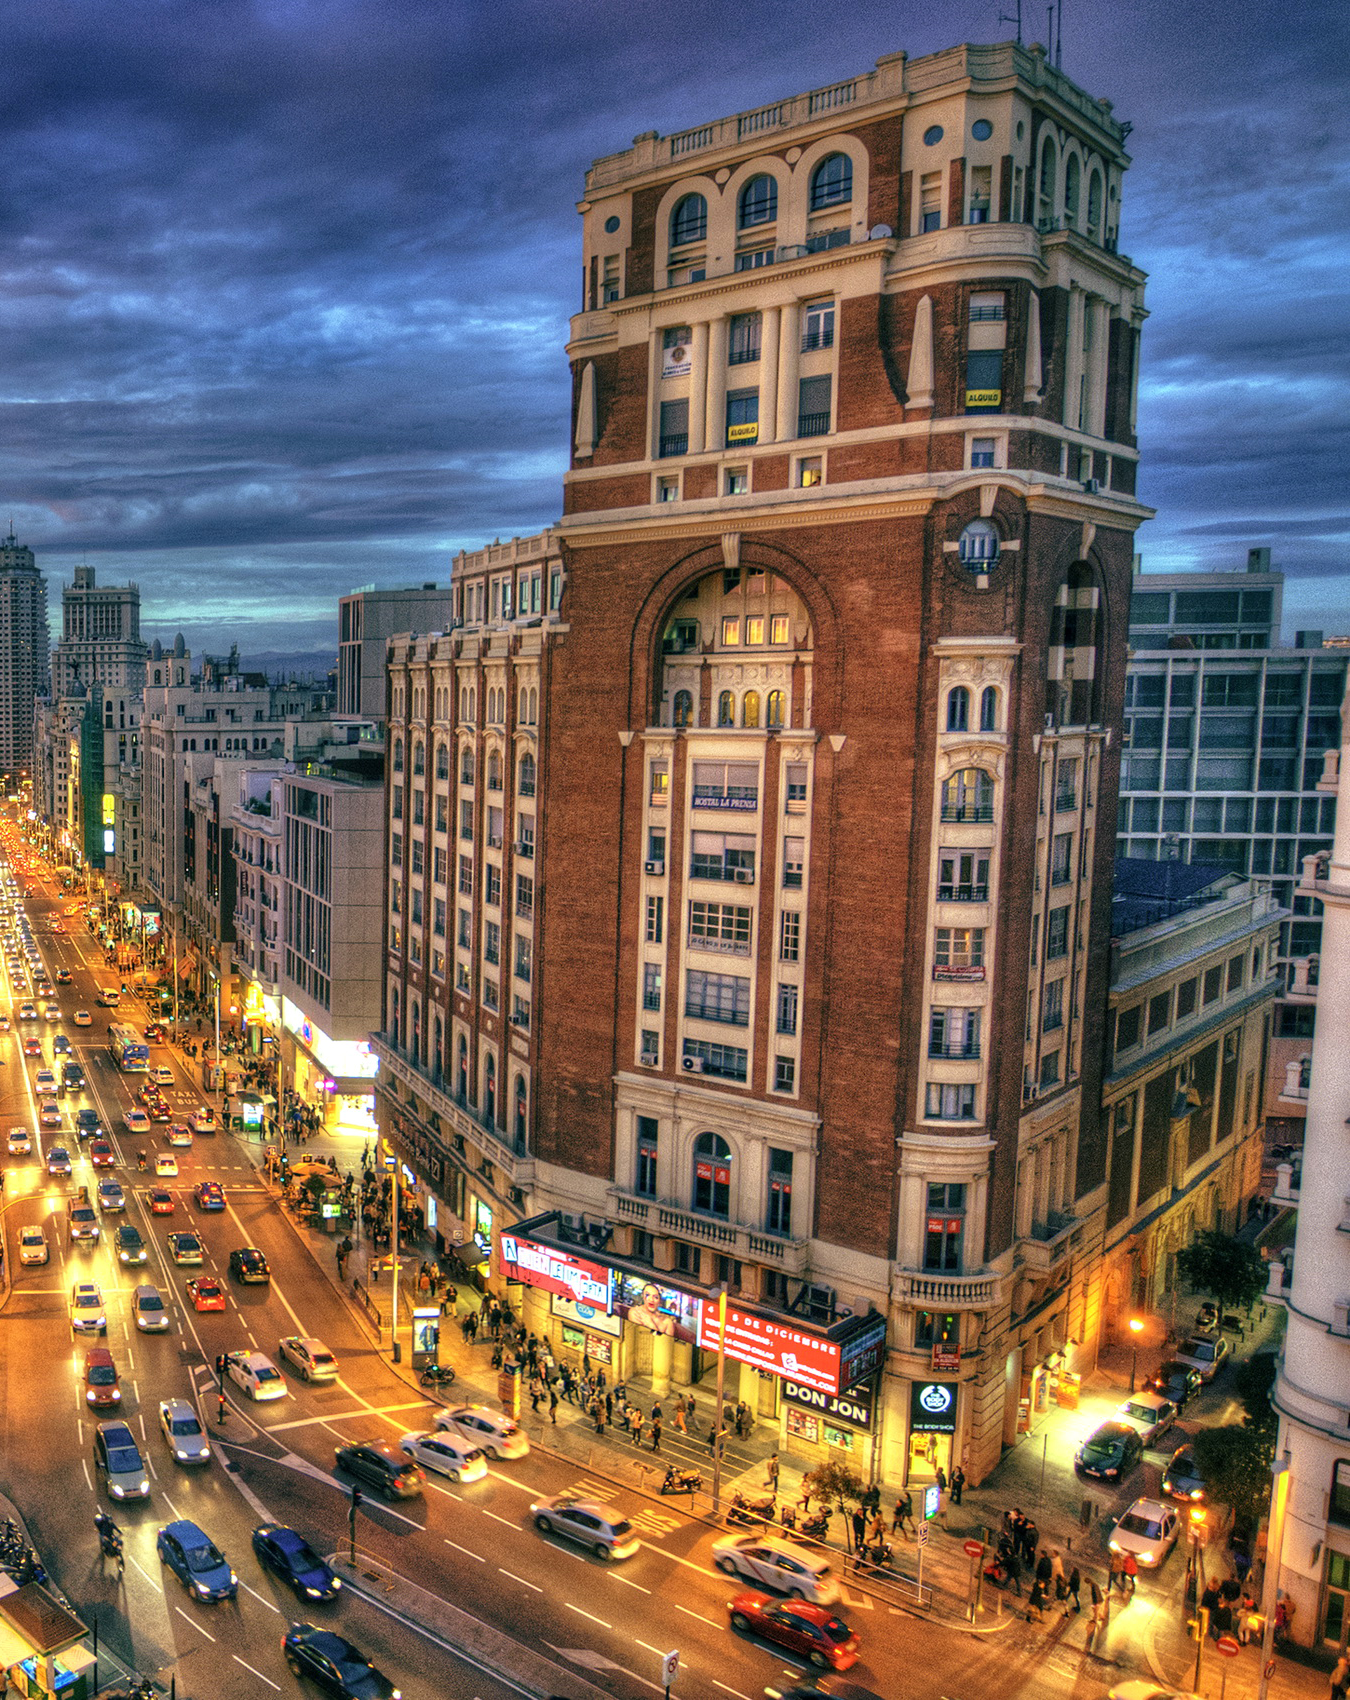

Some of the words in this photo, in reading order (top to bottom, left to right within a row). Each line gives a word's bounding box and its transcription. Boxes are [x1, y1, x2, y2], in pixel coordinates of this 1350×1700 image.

[694, 797, 720, 807] HOSTAL
[720, 798, 730, 807] LA
[744, 1317, 760, 1329] DE
[765, 1324, 837, 1356] DICIEMBRE
[786, 1381, 826, 1408] DON
[829, 1398, 867, 1423] JON
[628, 1509, 682, 1539] BUS
